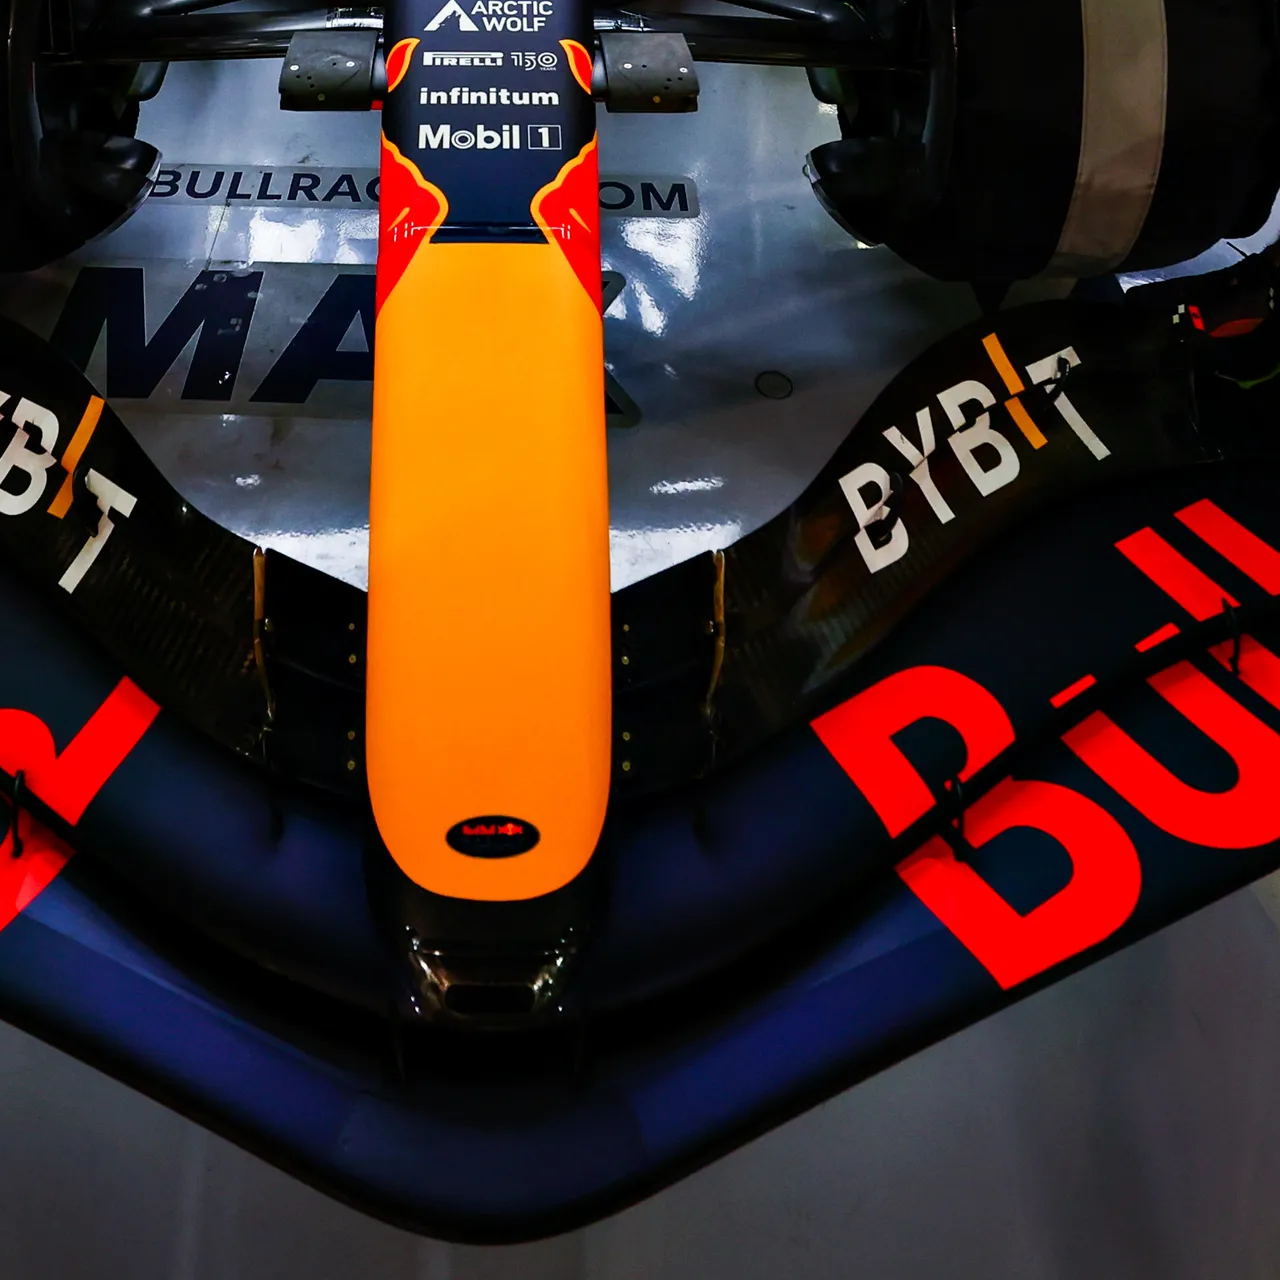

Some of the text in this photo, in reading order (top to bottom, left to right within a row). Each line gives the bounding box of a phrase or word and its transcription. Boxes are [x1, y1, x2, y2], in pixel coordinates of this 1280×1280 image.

[471, 0, 553, 16] ARCTIC
[483, 16, 546, 32] WOLF
[423, 51, 558, 71] PIRELLI 150
[420, 87, 559, 105] infinitum
[419, 124, 520, 150] Mobil
[839, 331, 1111, 575] BYBIT
